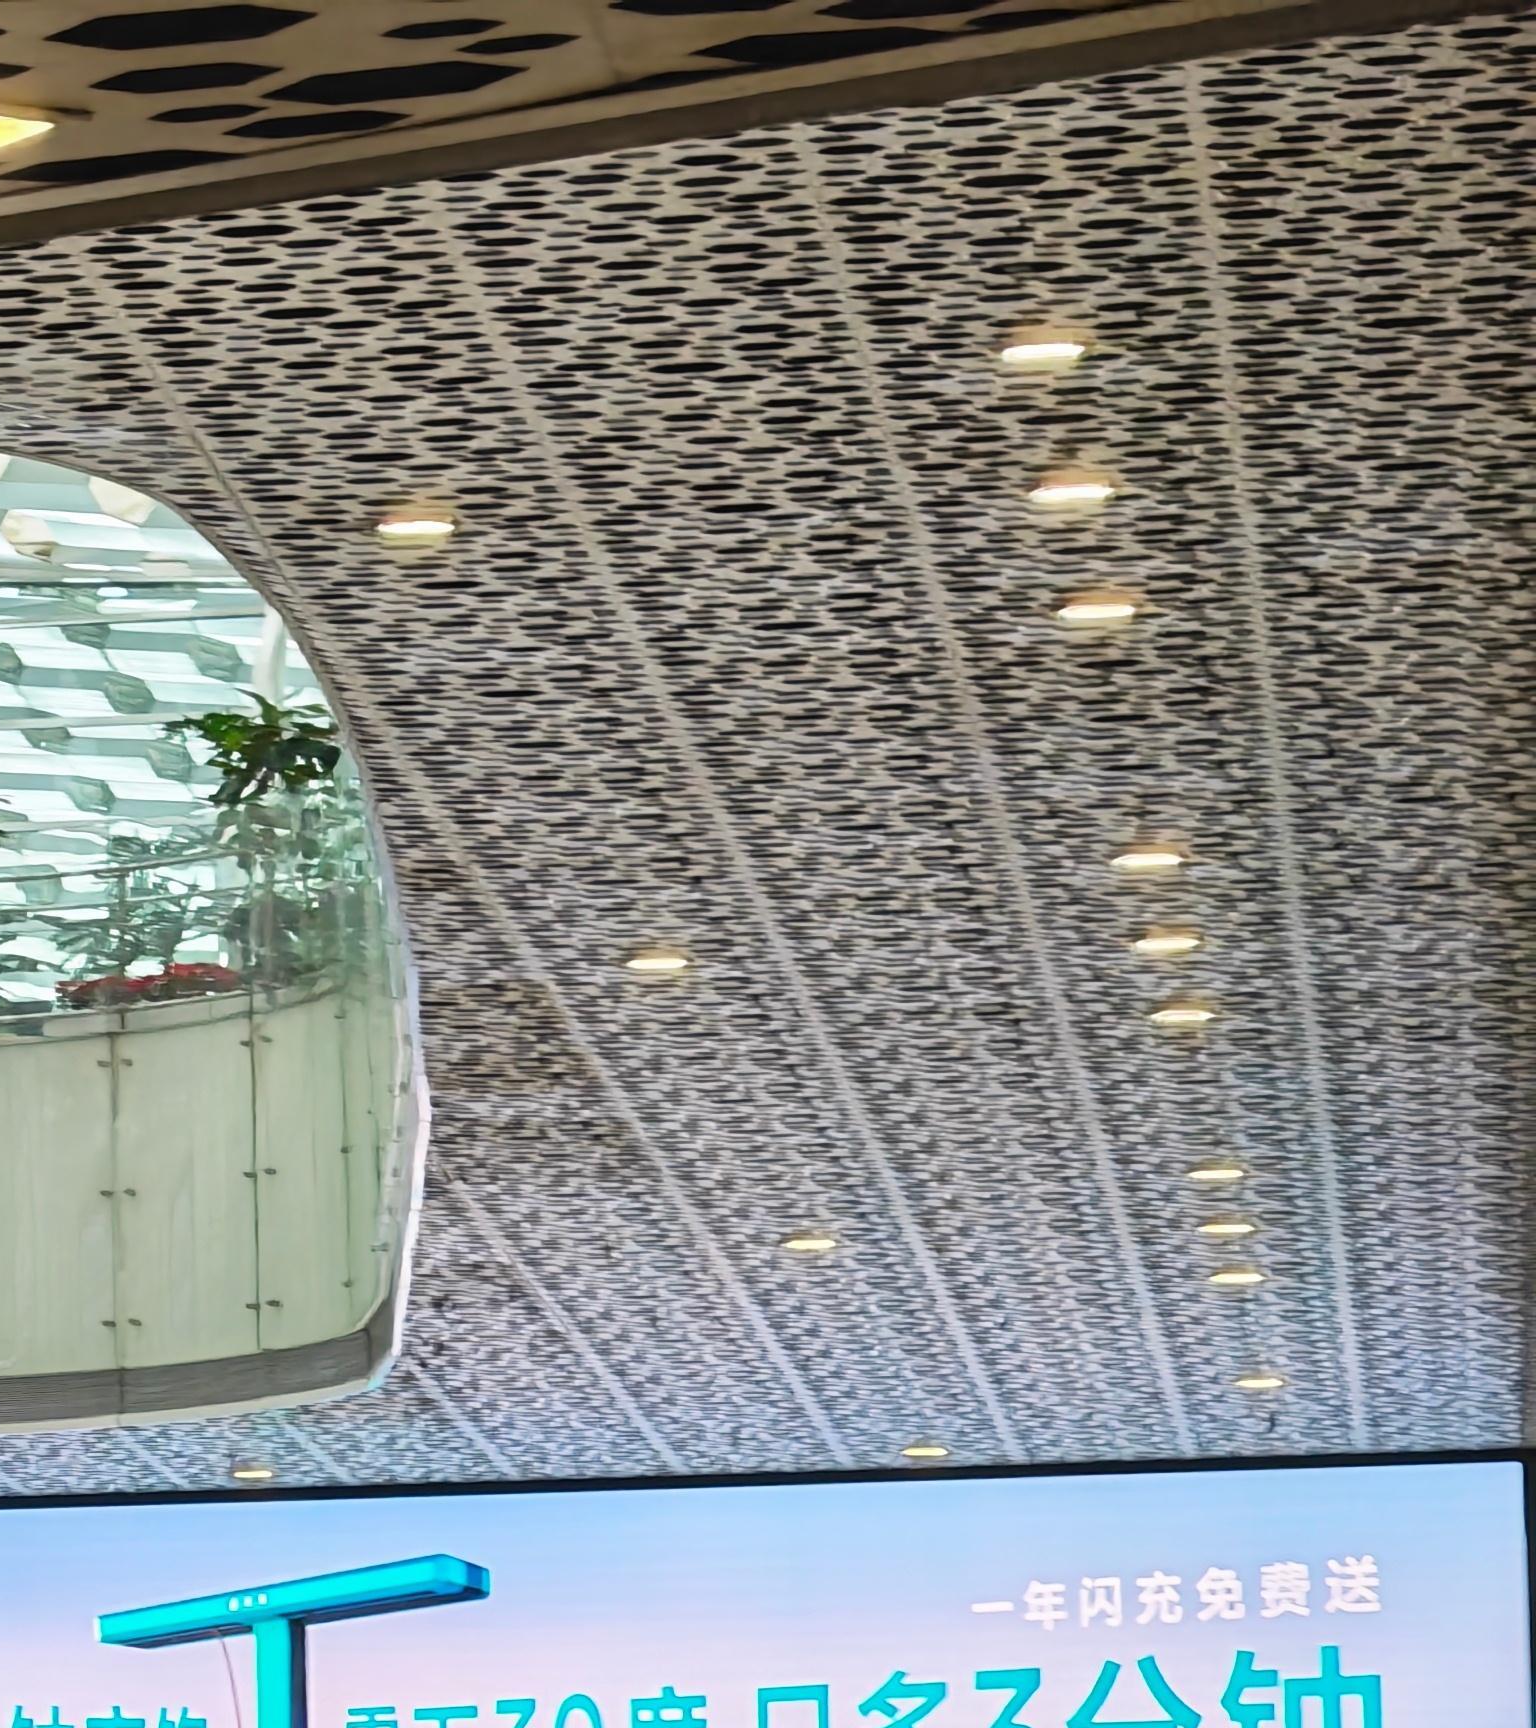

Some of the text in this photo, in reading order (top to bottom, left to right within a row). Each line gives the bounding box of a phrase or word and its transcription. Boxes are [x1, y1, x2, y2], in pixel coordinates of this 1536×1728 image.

[971, 1556, 1383, 1630] 一年闪充免费送
